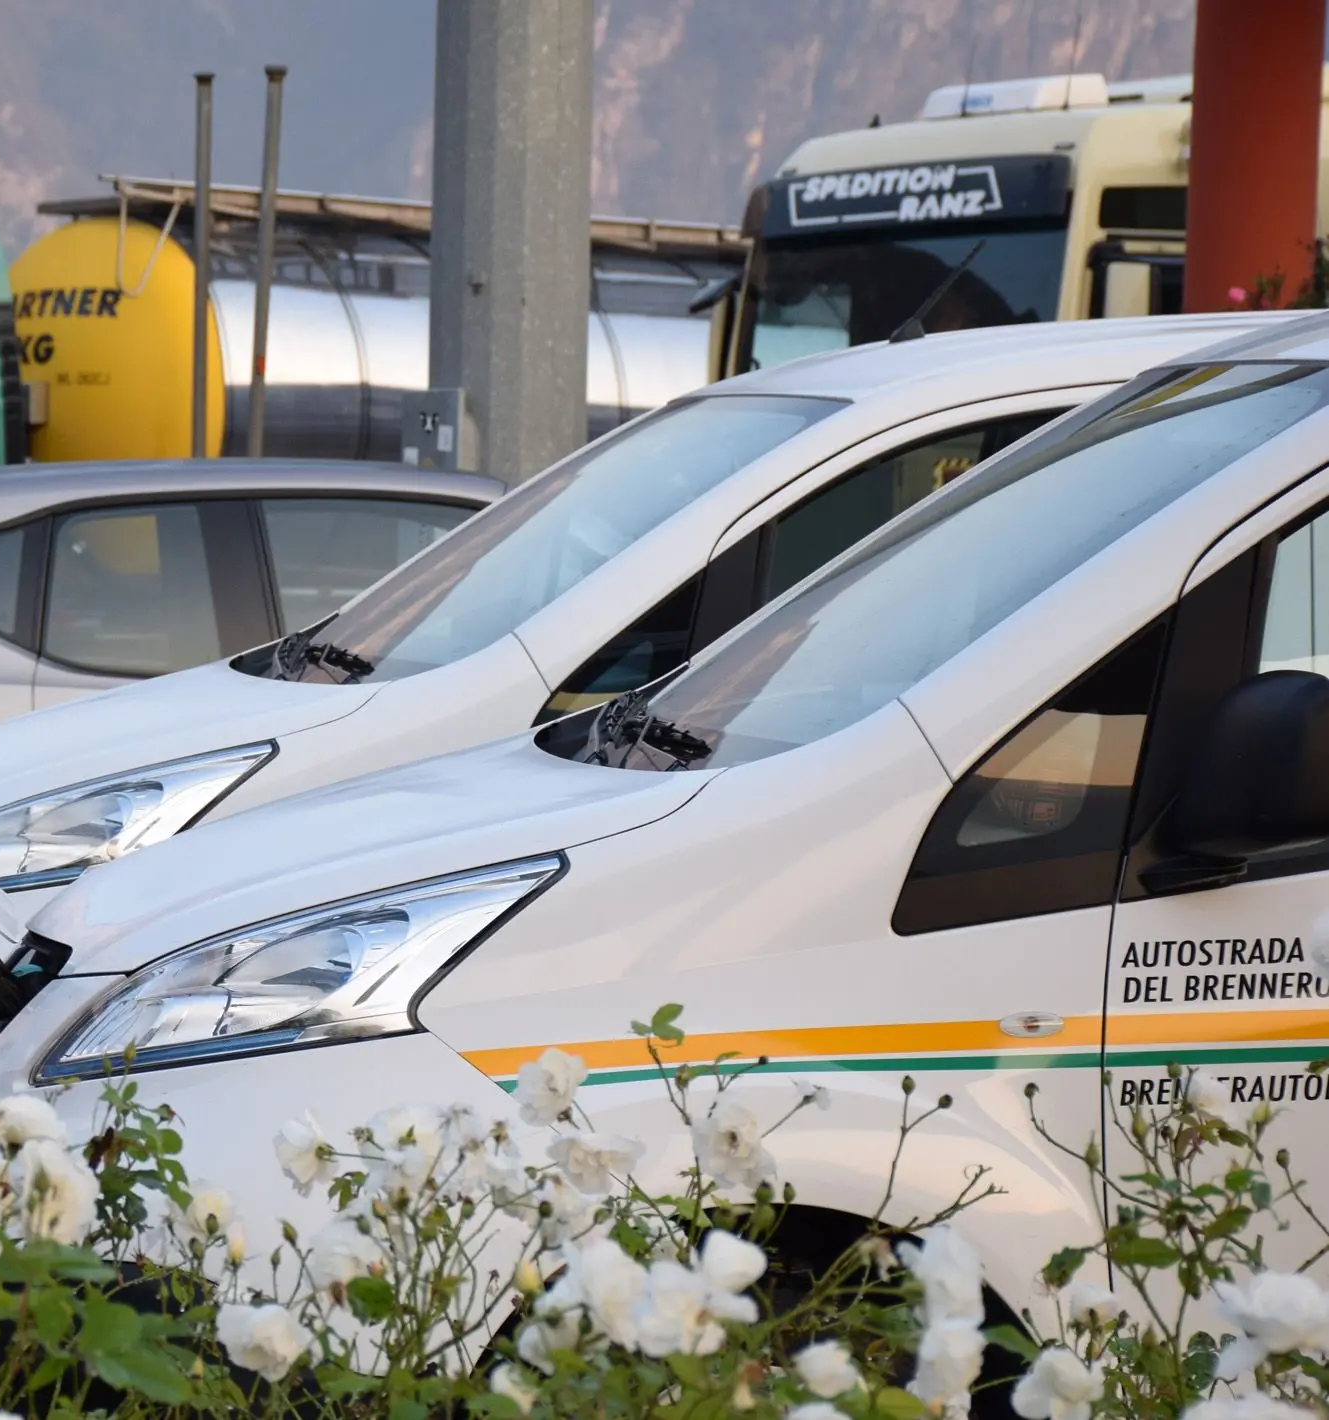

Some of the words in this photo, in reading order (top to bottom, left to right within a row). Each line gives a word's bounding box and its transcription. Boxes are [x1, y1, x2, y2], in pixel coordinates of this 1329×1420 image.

[801, 164, 956, 203] SPEDITION
[898, 189, 986, 223] RANZ
[1121, 937, 1305, 969] AUTOSTRADA
[1123, 976, 1174, 1004] DEL
